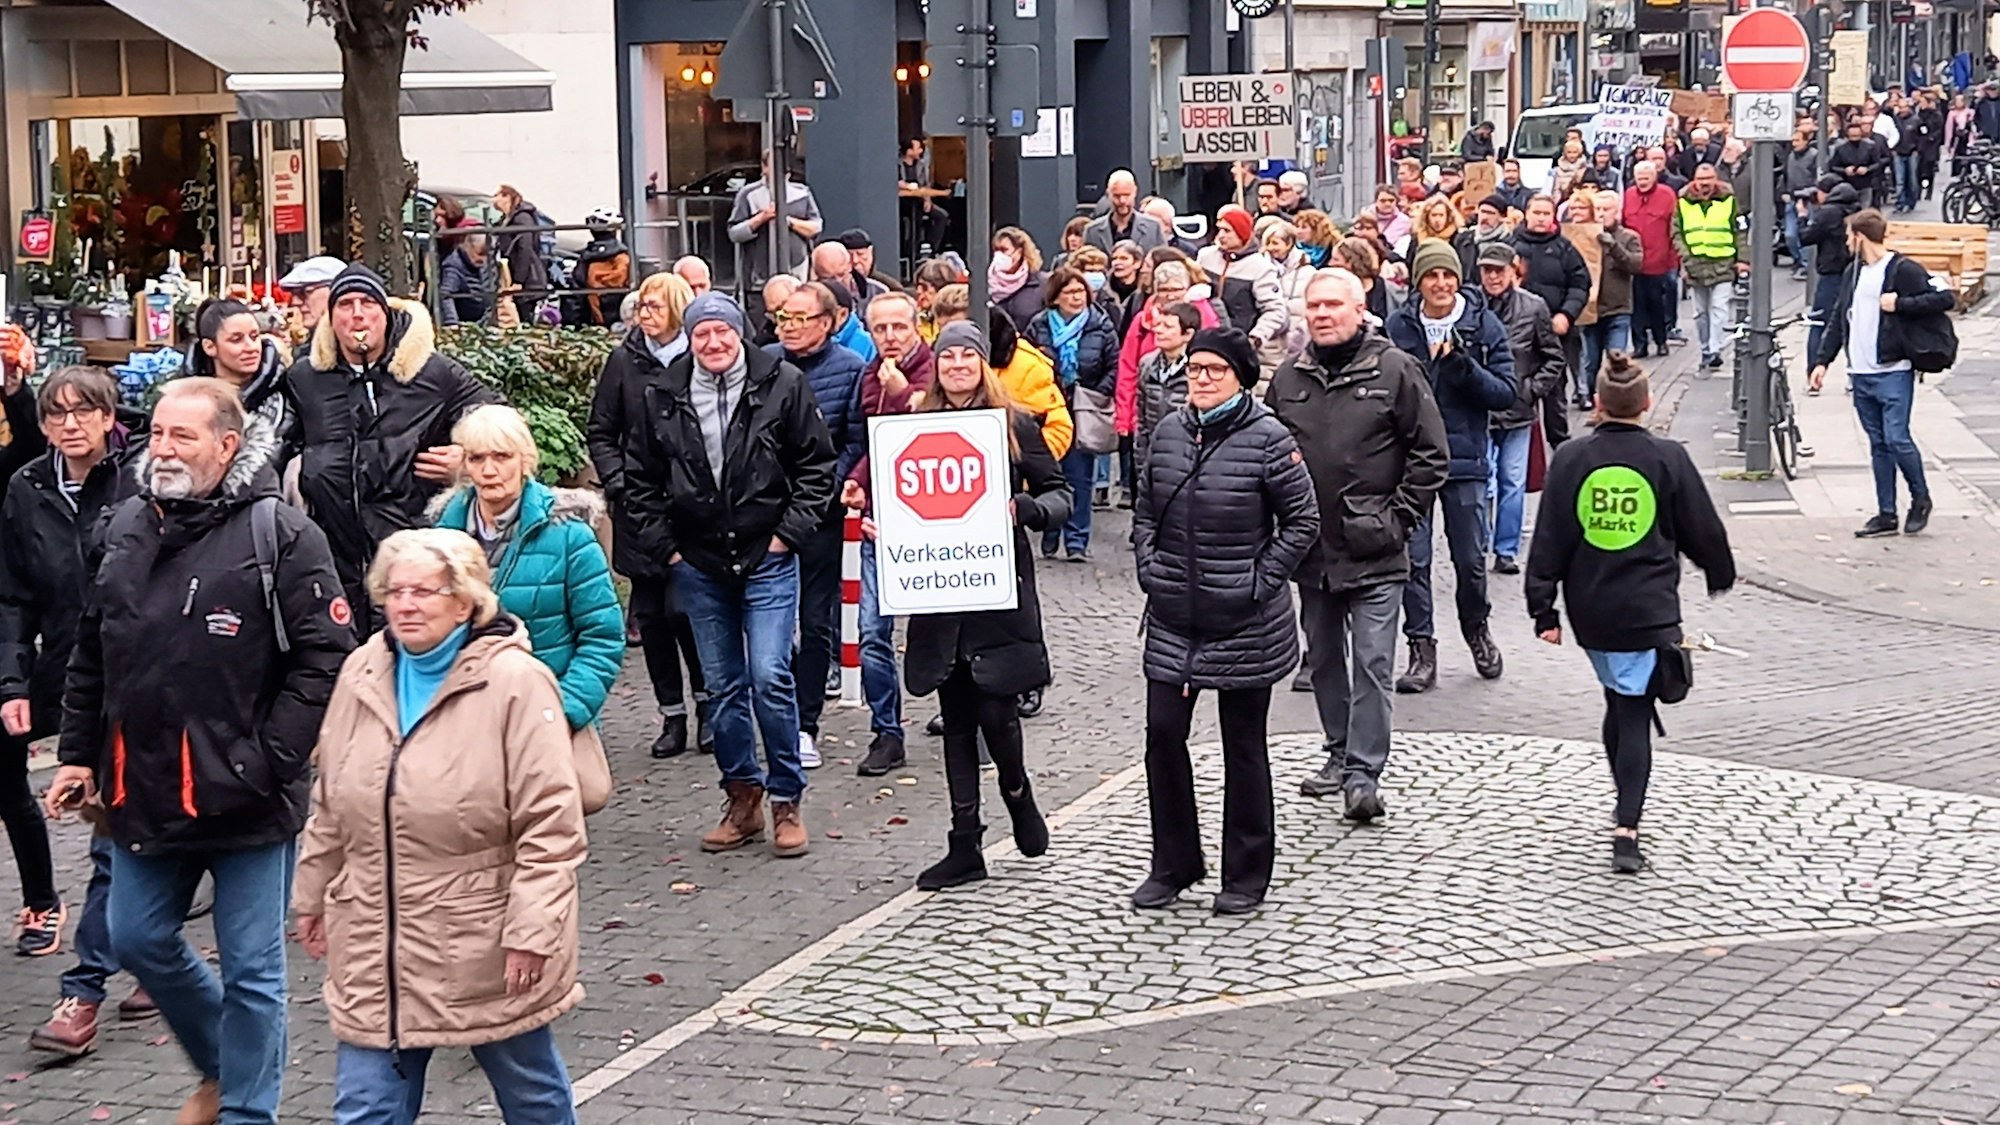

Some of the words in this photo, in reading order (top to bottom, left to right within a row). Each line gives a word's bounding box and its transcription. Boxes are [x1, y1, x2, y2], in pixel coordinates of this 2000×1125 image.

[1180, 80, 1242, 103] LEBEN
[1251, 80, 1271, 103] &
[1606, 86, 1671, 107] IGNORANZ
[1181, 104, 1292, 128] ÜBERLEBEN
[1182, 131, 1257, 153] LASSEN
[900, 455, 981, 497] STOP
[1588, 517, 1637, 533] Markt
[887, 542, 1004, 564] Verkacken
[899, 570, 996, 591] verboten
